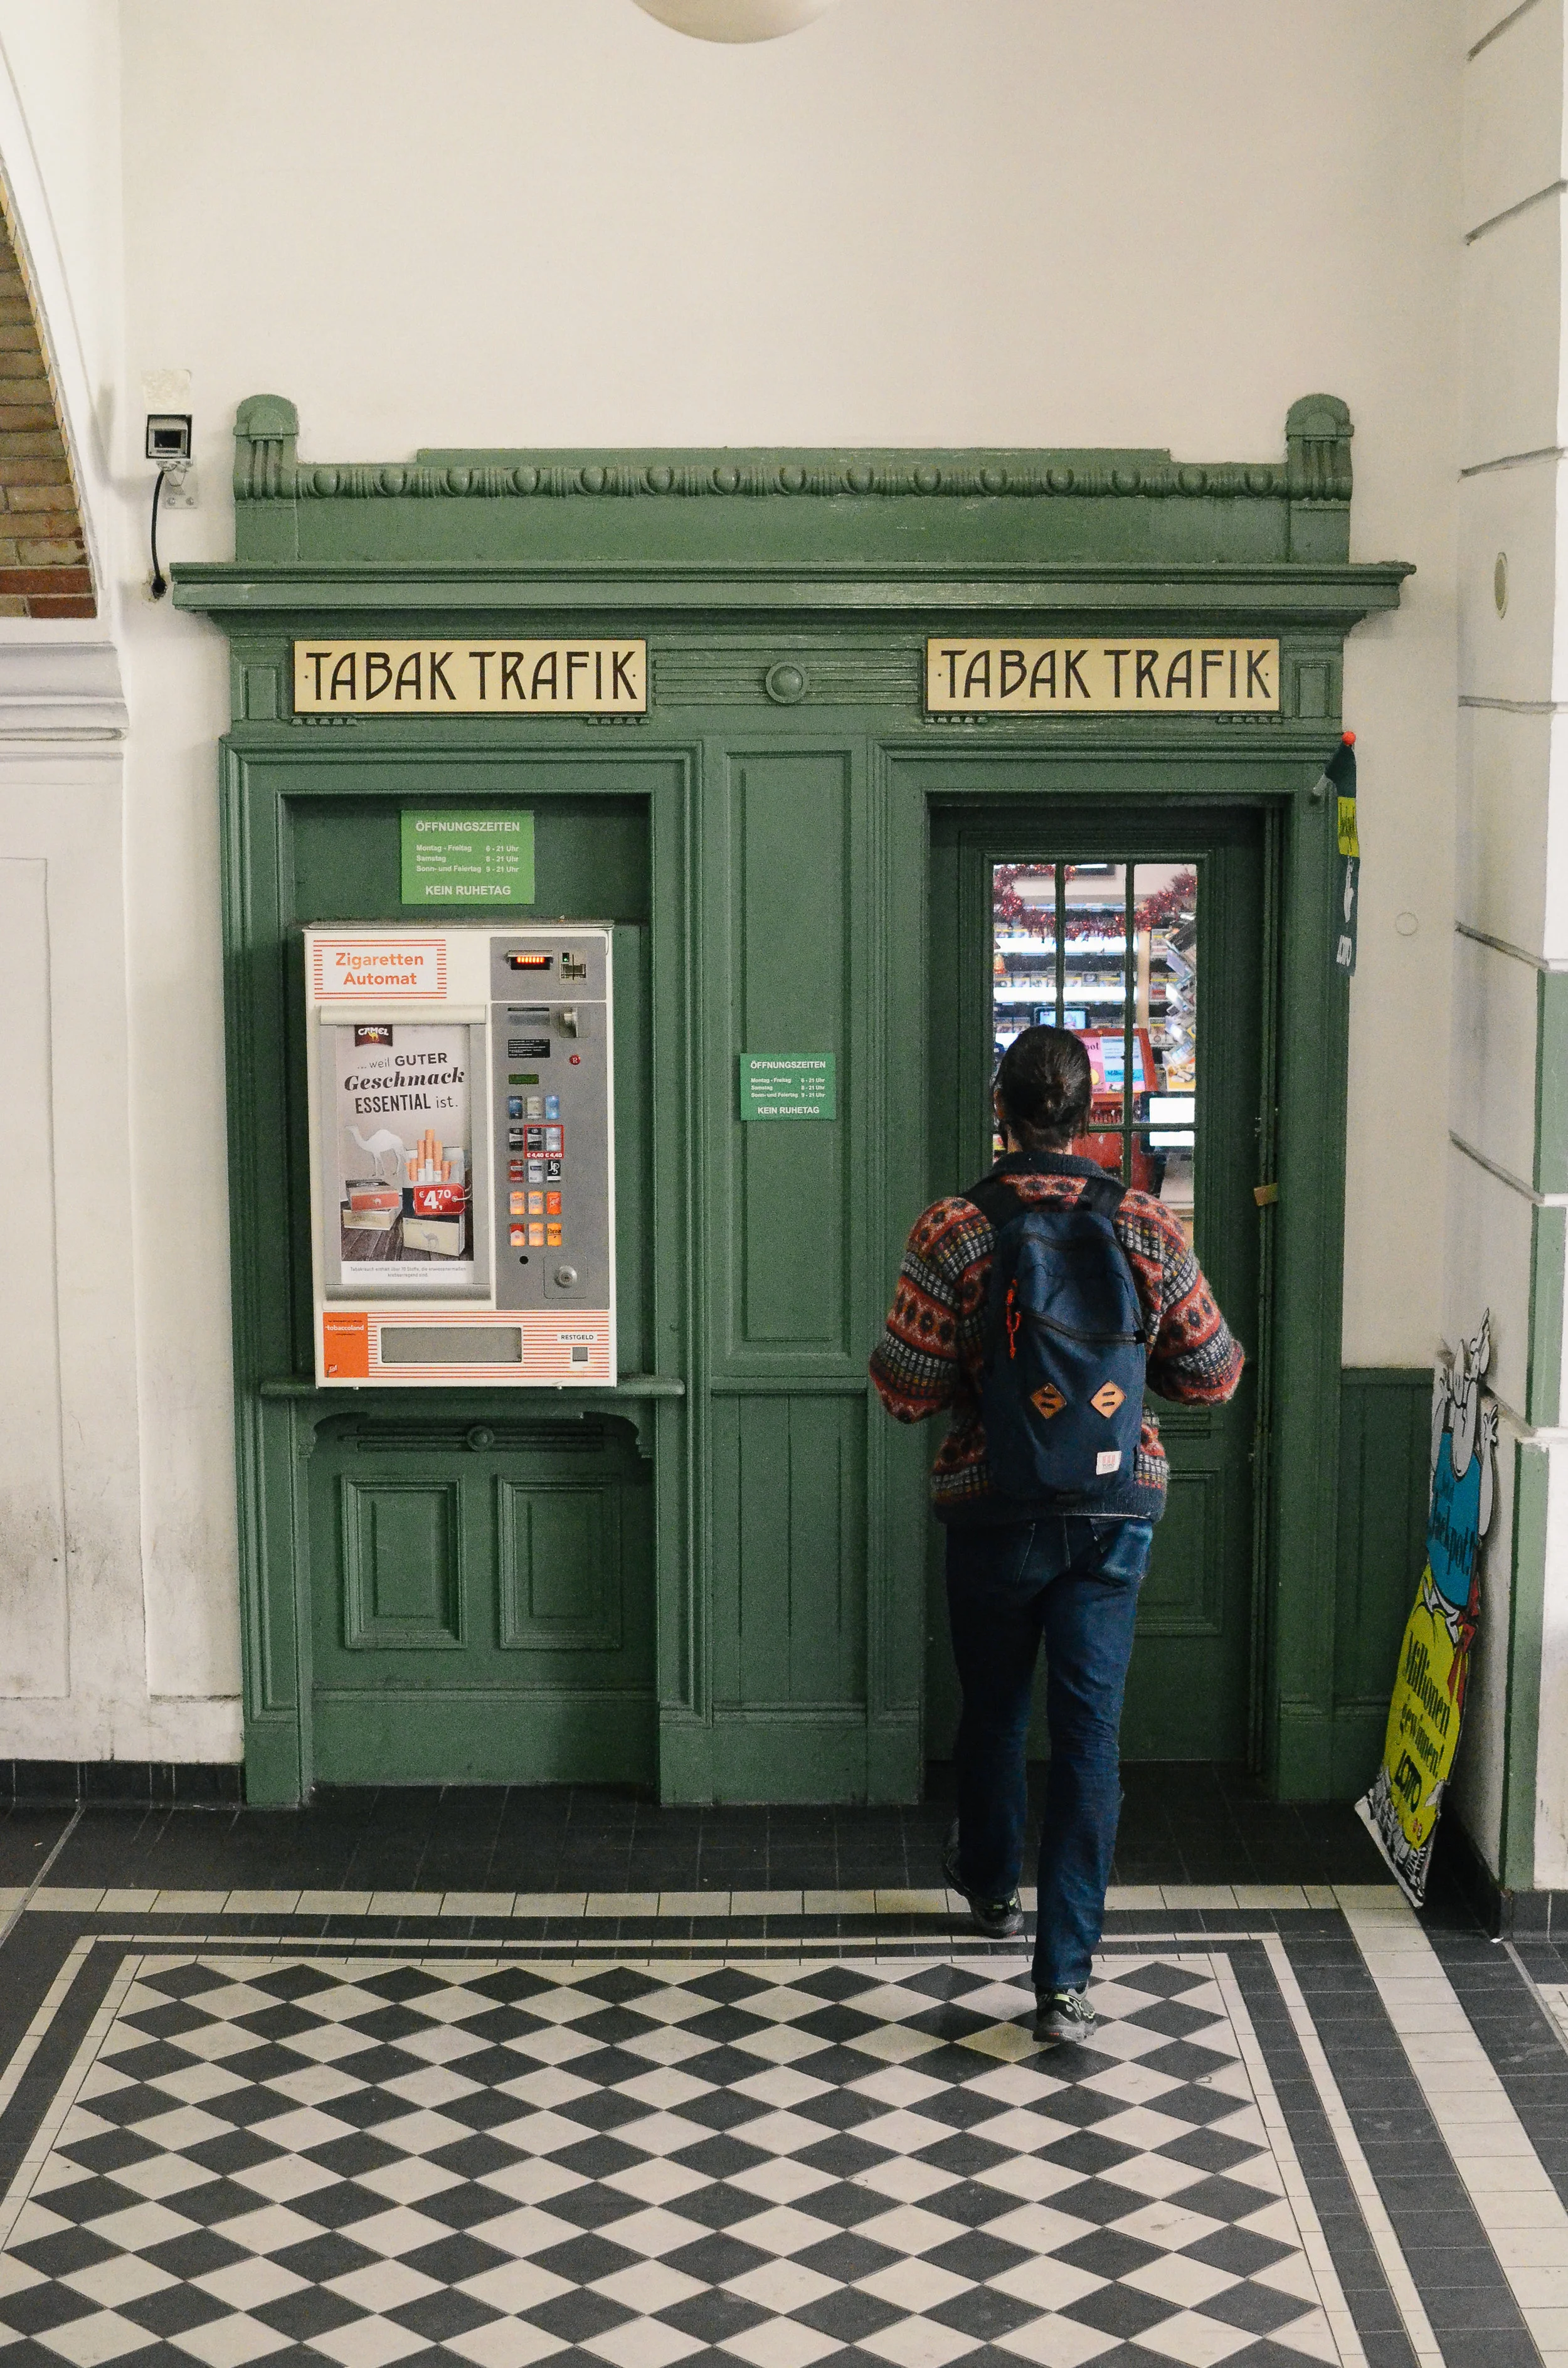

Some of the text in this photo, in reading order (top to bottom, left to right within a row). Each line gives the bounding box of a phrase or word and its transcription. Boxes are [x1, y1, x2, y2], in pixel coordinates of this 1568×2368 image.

[305, 650, 638, 701] TABAK TRAFIK
[940, 649, 1271, 698] TABAK TRAFIK
[415, 820, 520, 832] ÖFFNUNGSZEITEN
[426, 886, 511, 895] KEIN RUHETAG
[336, 952, 424, 970] Zigaretten
[343, 972, 417, 985] Automat
[358, 1027, 389, 1036] CAMEL
[369, 1058, 390, 1068] weil
[395, 1053, 448, 1066] GUTER
[751, 1061, 826, 1069] ÖFFNUNGSZEITEN
[344, 1067, 465, 1091] Geschmack
[355, 1093, 458, 1114] ESSENTIAL ist.
